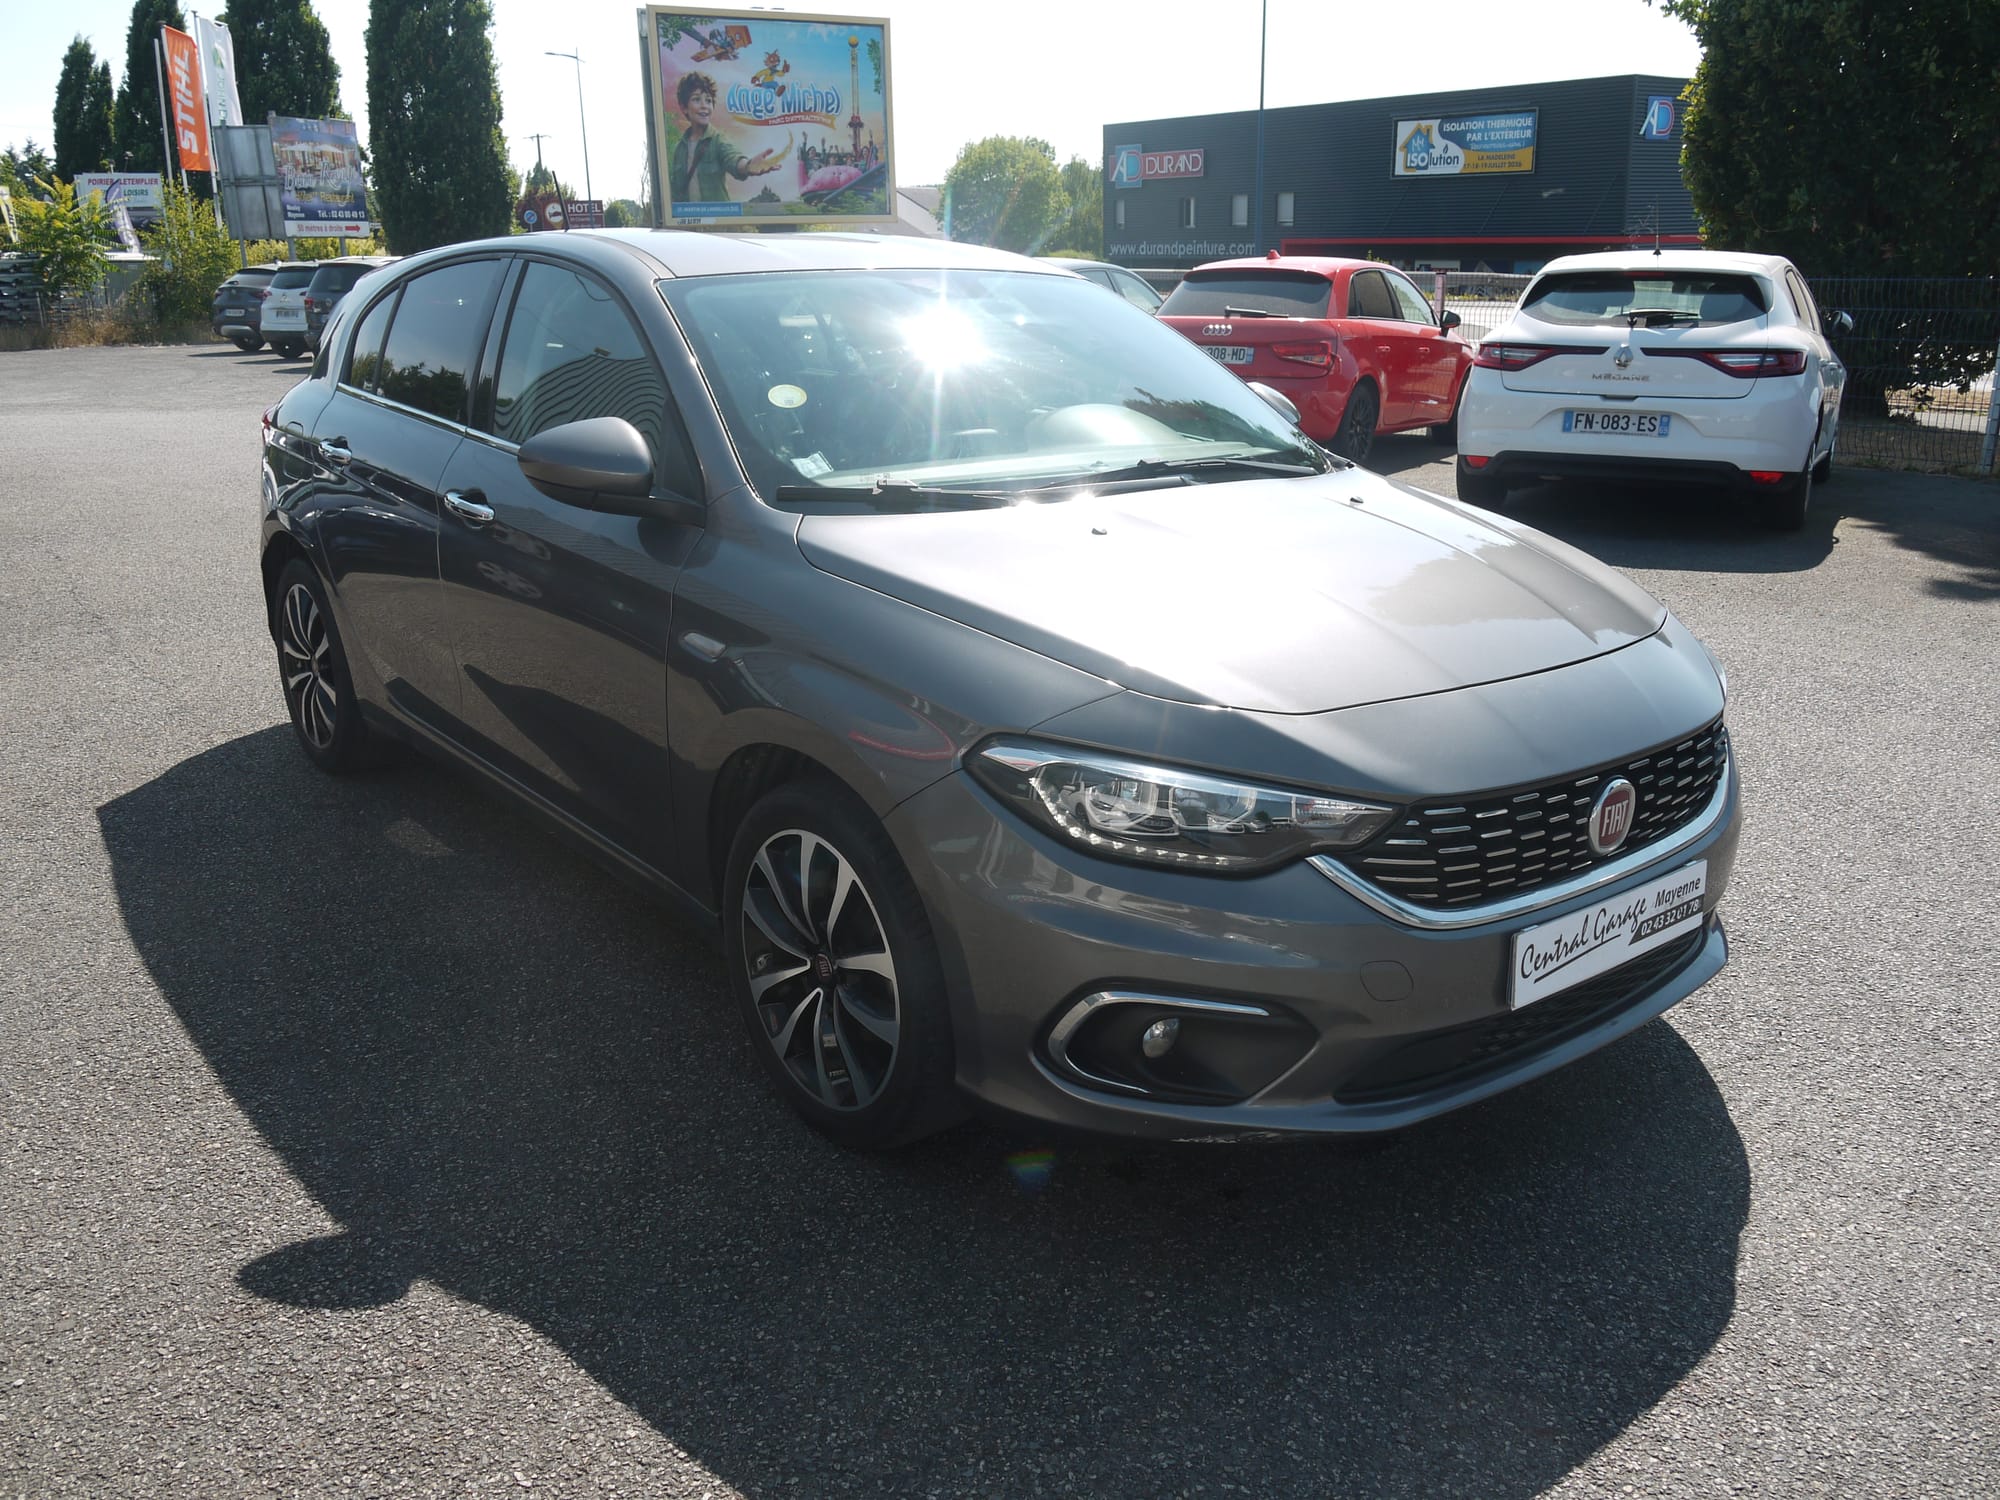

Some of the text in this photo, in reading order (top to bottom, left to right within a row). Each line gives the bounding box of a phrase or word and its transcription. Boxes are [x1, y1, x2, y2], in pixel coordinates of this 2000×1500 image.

[174, 48, 199, 154] STIHL
[727, 81, 841, 119] Ange Michel
[1443, 117, 1533, 132] ISOLATION THERMIQUE
[1466, 132, 1482, 142] PAR
[1145, 153, 1202, 175] DURAND
[123, 188, 149, 196] LOISIRS
[1109, 239, 1256, 257] www.durandpeinture.com
[1574, 412, 1658, 432] FN-083-ES
[1601, 799, 1629, 837] FIAT
[1520, 877, 1701, 979] Central Garage Mayenne
